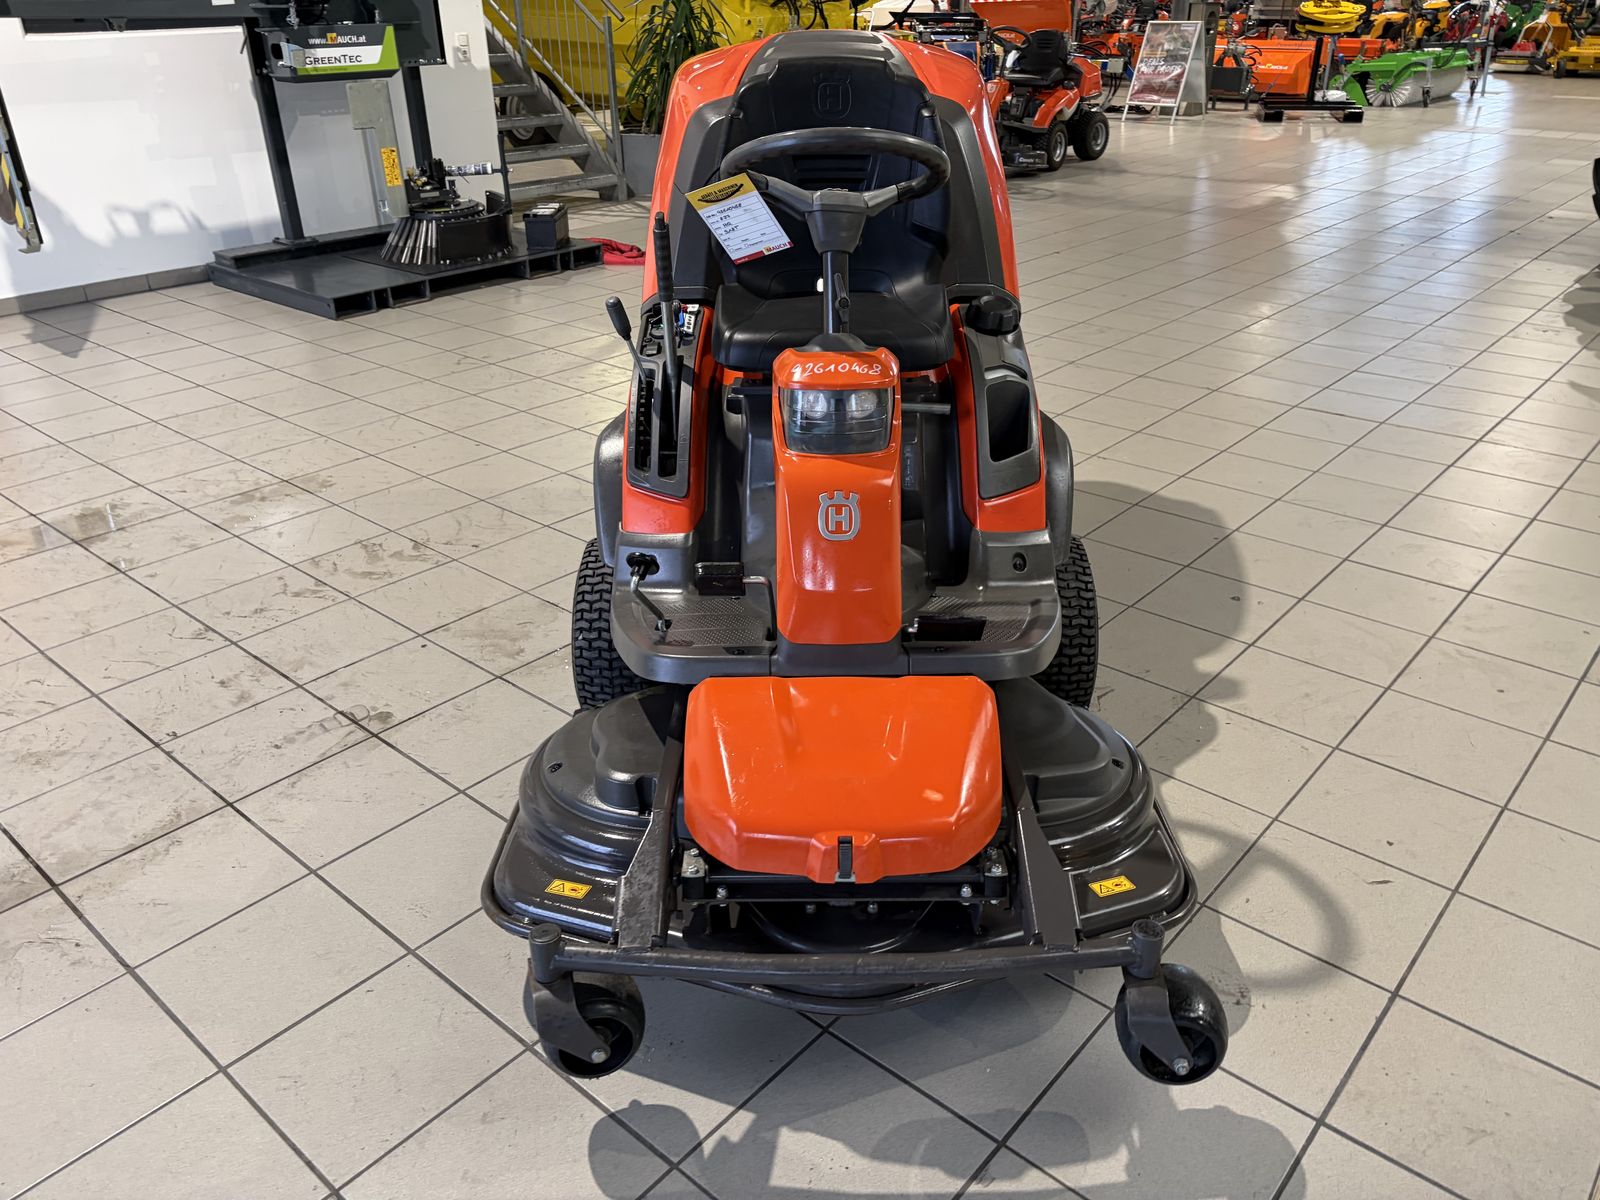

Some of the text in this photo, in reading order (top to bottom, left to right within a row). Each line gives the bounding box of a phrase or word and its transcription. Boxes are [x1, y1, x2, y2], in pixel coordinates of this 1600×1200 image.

[1143, 57, 1165, 67] DEALS
[766, 243, 788, 252] MAUCH
[791, 362, 882, 379] 92610468
